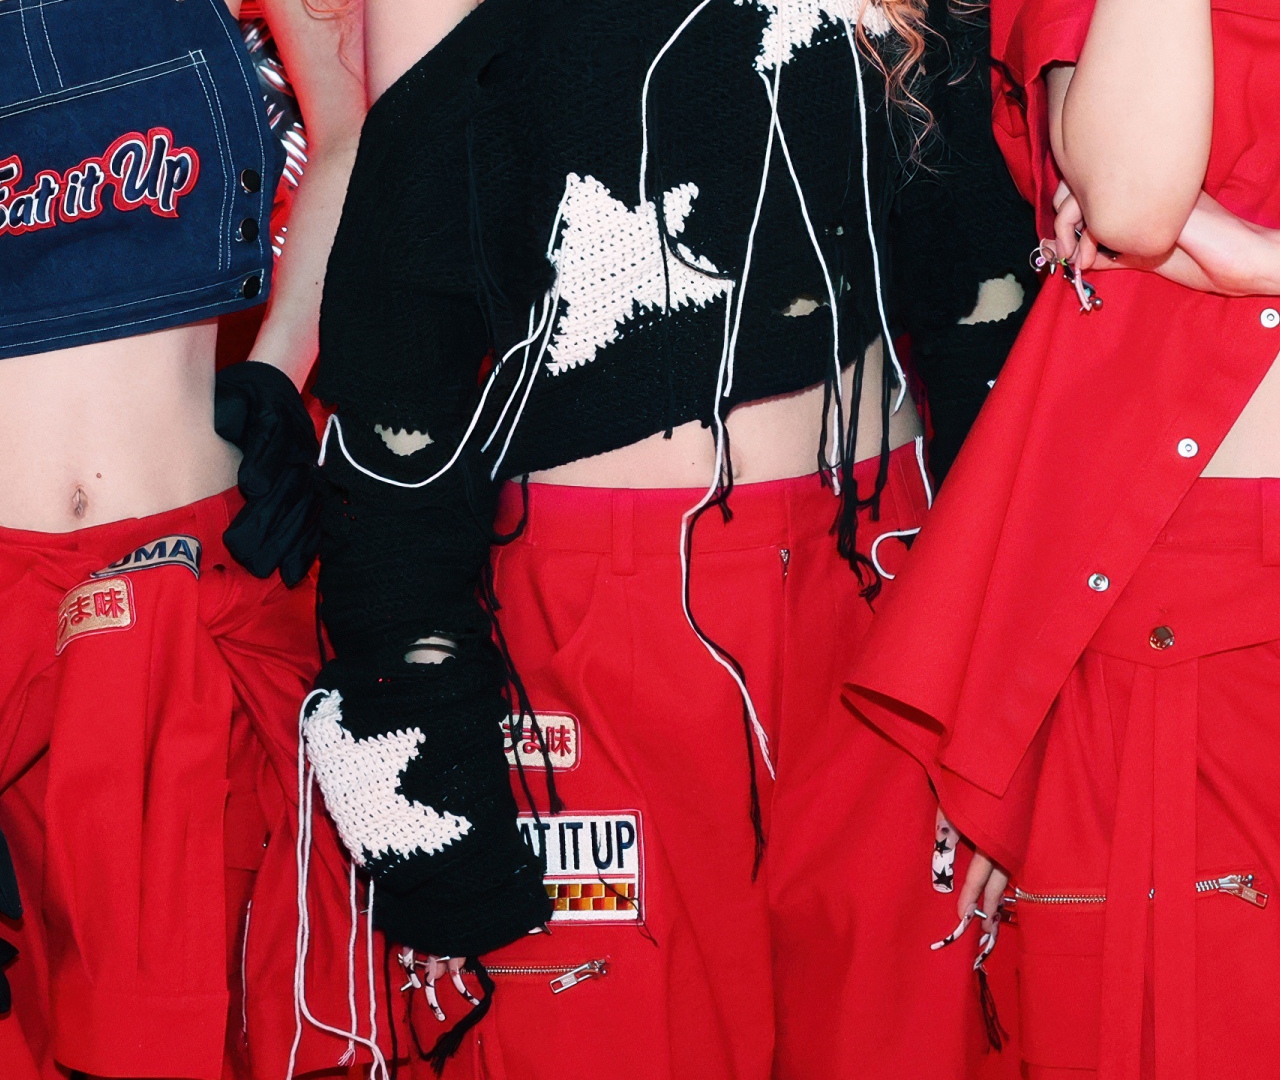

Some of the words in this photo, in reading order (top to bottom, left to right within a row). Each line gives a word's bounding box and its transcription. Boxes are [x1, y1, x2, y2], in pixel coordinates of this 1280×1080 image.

[63, 161, 105, 218] it
[110, 133, 194, 213] Up
[558, 822, 584, 871] IT
[590, 820, 636, 870] UP
